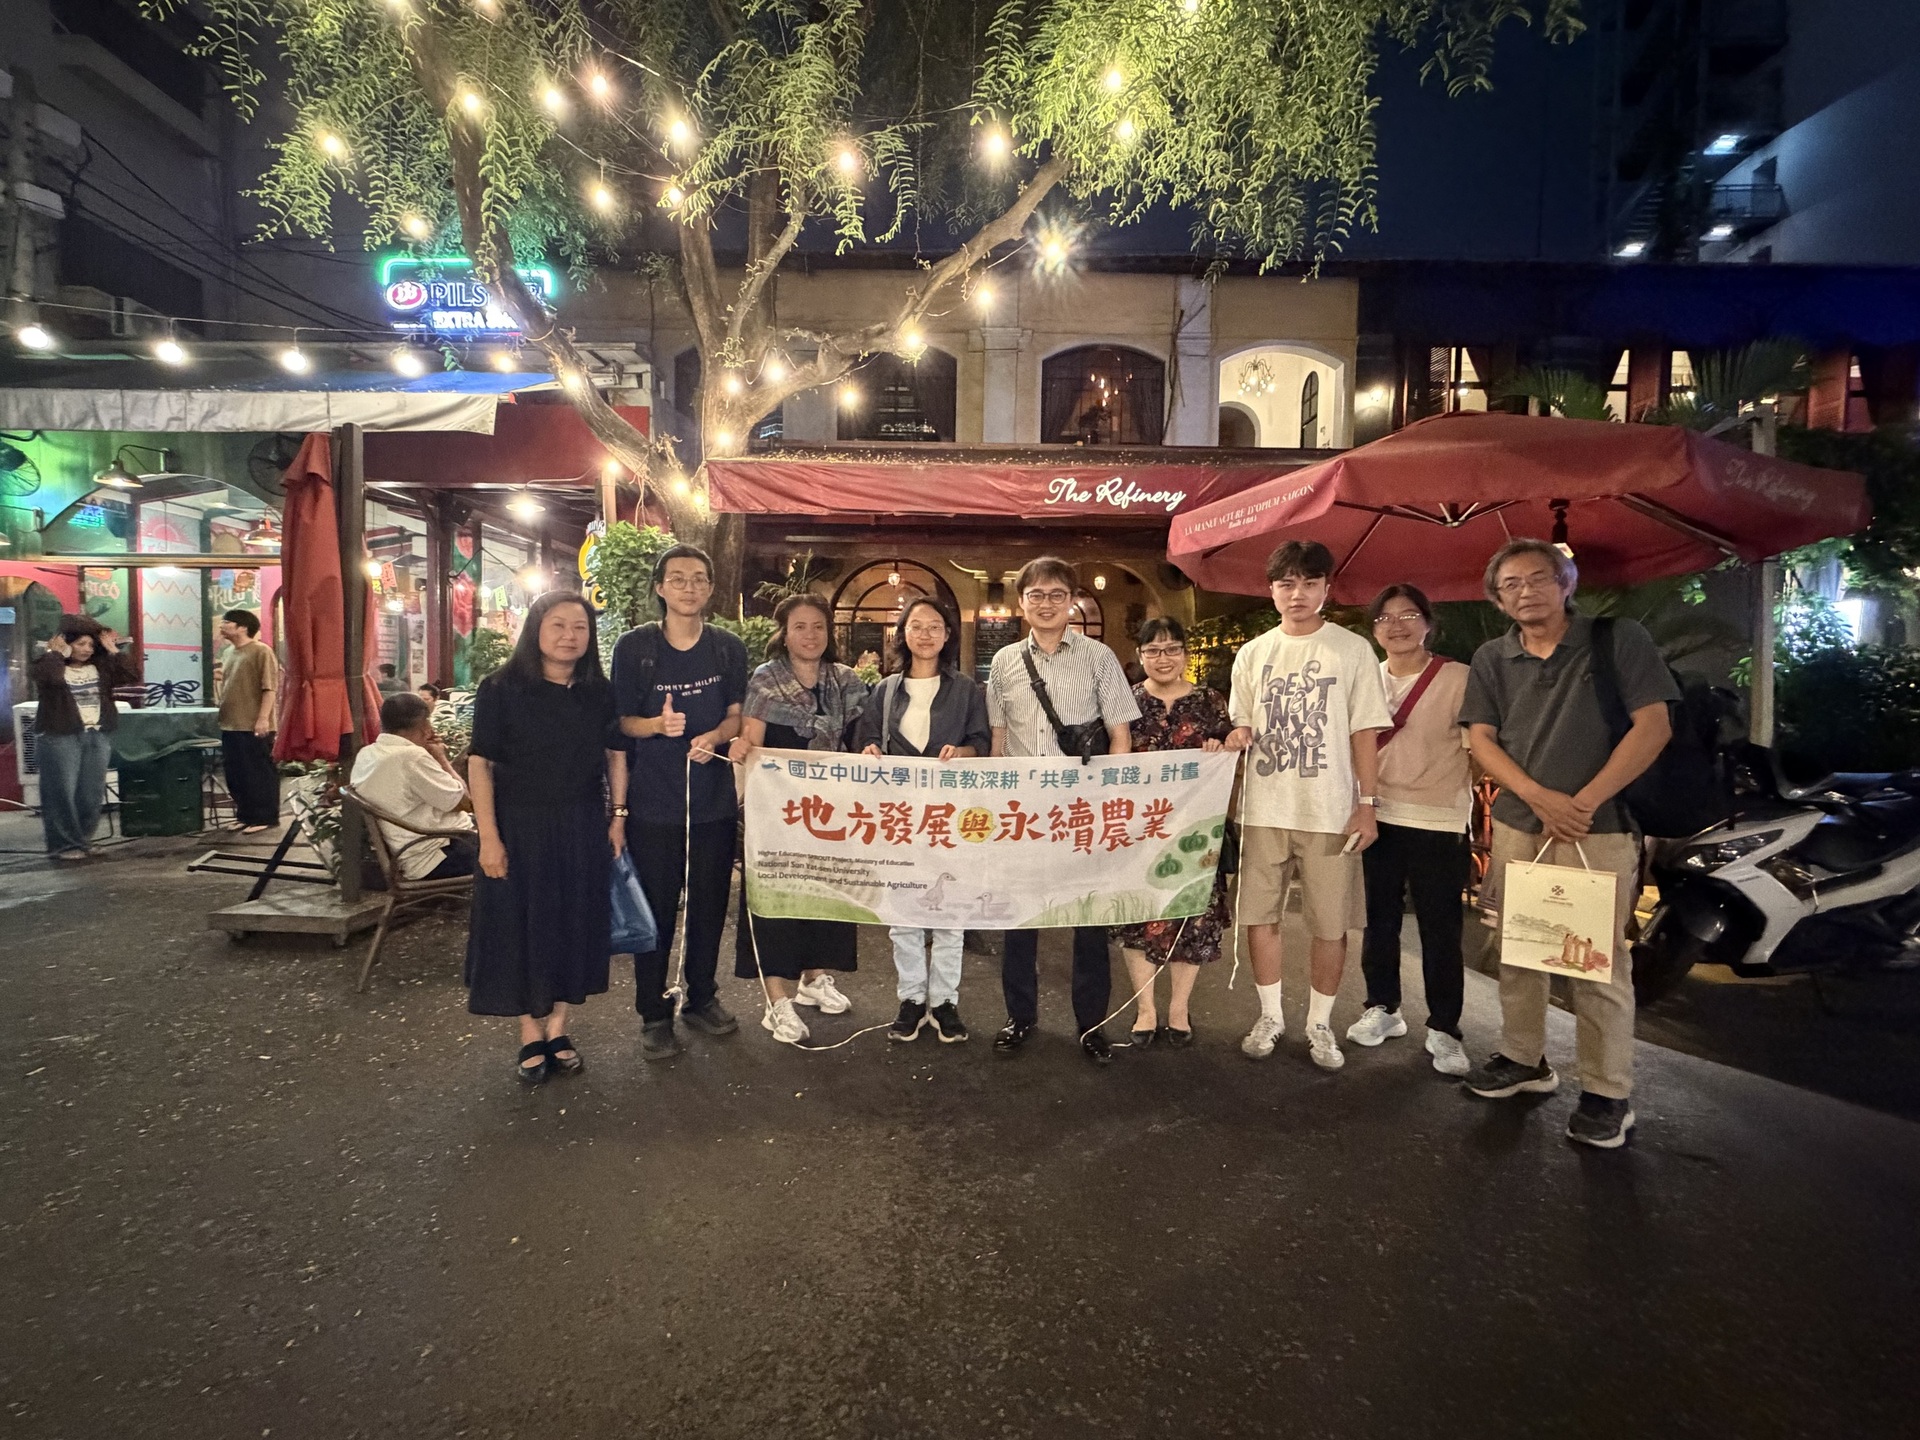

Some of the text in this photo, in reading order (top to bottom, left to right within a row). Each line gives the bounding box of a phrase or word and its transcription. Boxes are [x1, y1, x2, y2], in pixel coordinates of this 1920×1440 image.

[1044, 477, 1186, 511] The Refinery
[1193, 508, 1245, 532] MANUFACTURE
[1281, 484, 1315, 503] SAIGON
[788, 759, 910, 786] 國立中山大學
[782, 794, 1174, 856] 地方發展與永續農業
[758, 850, 777, 858] Higher
[779, 850, 807, 858] Education
[808, 853, 831, 861] SPROUT
[855, 858, 877, 866] Ministry
[758, 860, 789, 868] National
[833, 866, 869, 877] University
[758, 871, 928, 890] Local Development and Sustainable Agriculture
